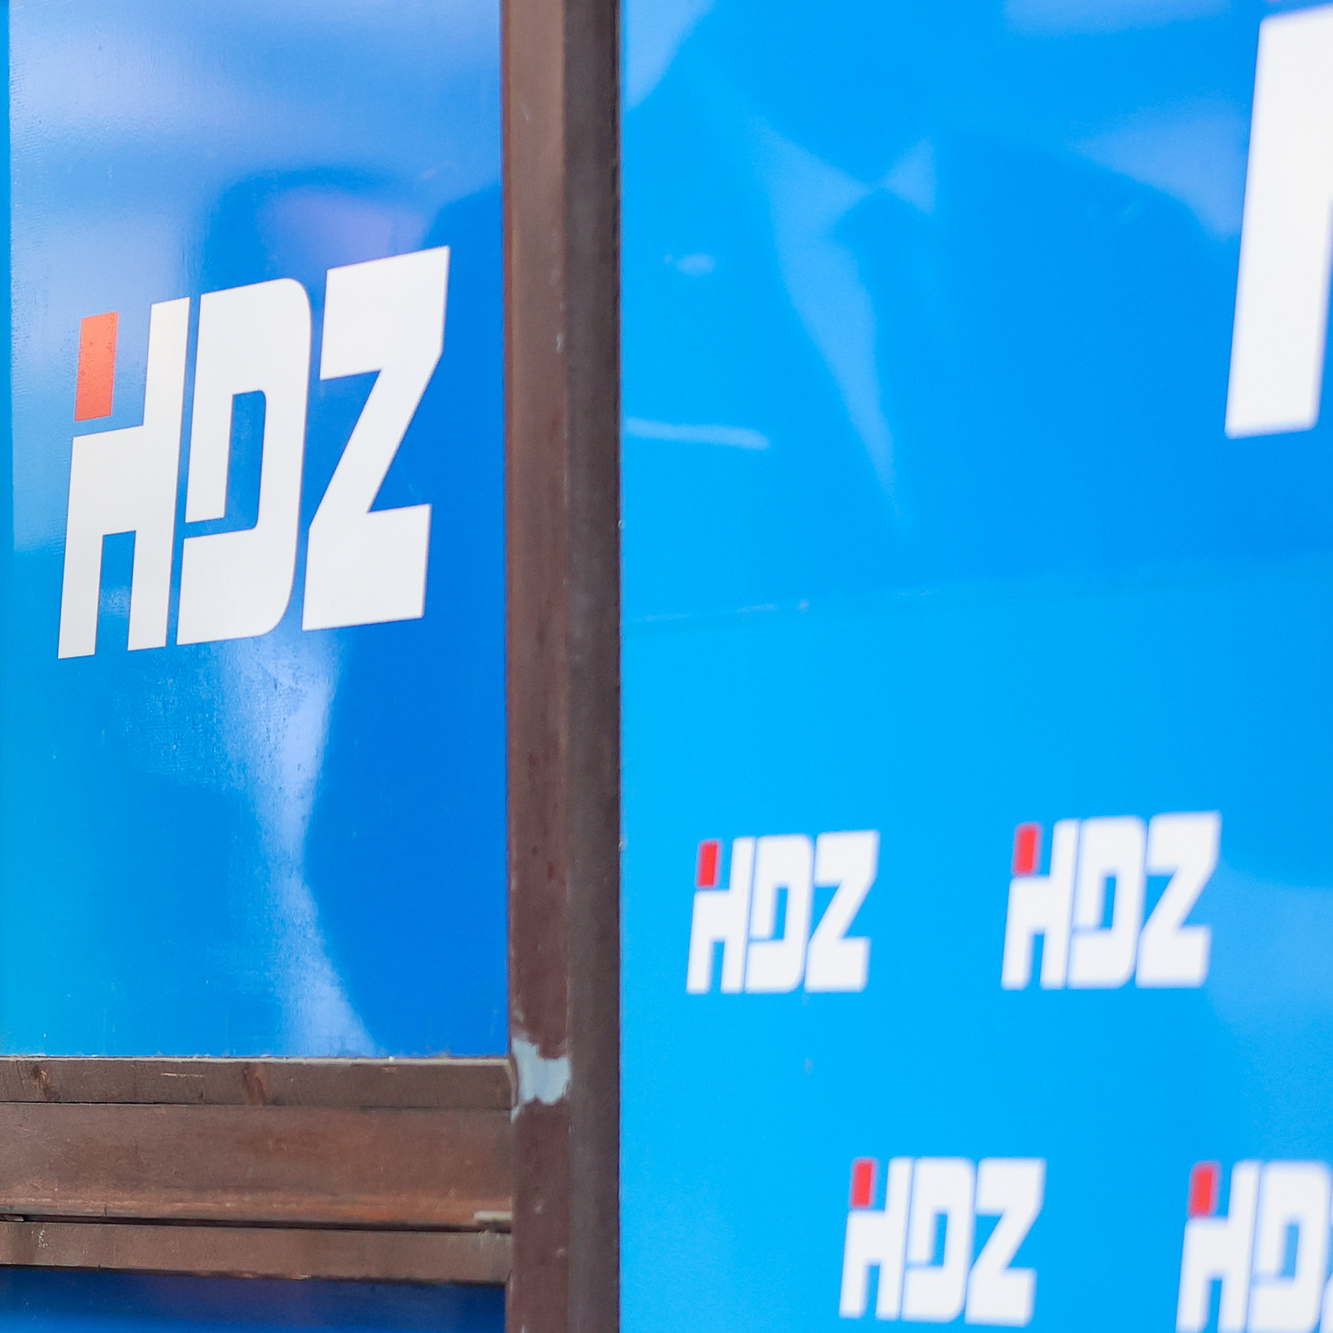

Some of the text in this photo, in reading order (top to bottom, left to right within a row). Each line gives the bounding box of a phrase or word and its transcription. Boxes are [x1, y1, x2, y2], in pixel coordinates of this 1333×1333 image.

[58, 246, 449, 658] HDZ
[687, 830, 879, 993] HDZ
[1002, 813, 1220, 989] HDZ
[840, 1157, 1045, 1326] HDZ
[1176, 1161, 1333, 1333] HD
